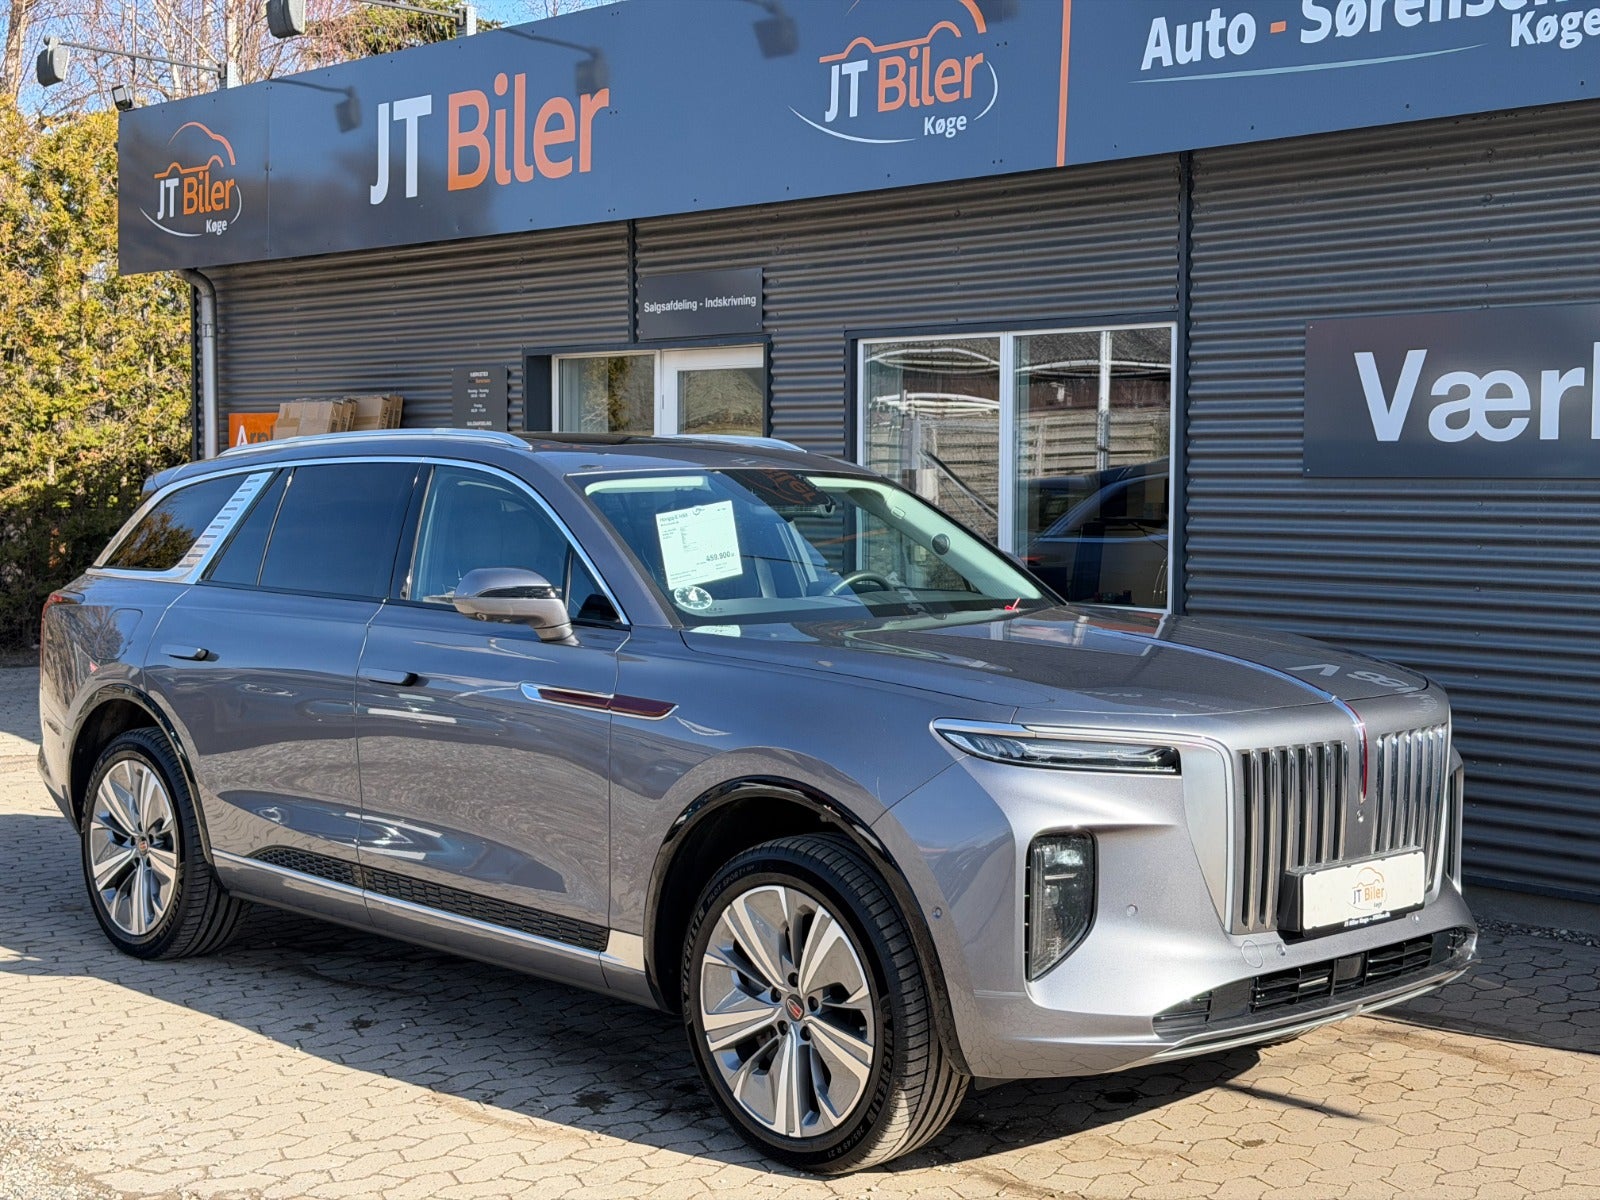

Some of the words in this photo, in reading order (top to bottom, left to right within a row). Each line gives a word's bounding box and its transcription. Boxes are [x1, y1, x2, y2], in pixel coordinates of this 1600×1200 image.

[1141, 7, 1257, 71] Auto
[1510, 7, 1600, 50] Køge
[825, 60, 869, 123] JT
[877, 46, 984, 113] Biler
[370, 95, 433, 206] JT
[447, 72, 610, 192] Biler
[923, 114, 968, 138] Køge
[157, 178, 180, 220] JT
[183, 170, 235, 215] Biler
[206, 219, 228, 236] Køge
[643, 299, 698, 314] Salgsafdeling
[705, 294, 757, 308] Indskrivning
[1353, 341, 1600, 443] Vær
[1352, 889, 1362, 904] JT
[1364, 886, 1385, 901] Biler
[682, 905, 706, 994] MICHELIN
[866, 1027, 894, 1124] MICHELIN
